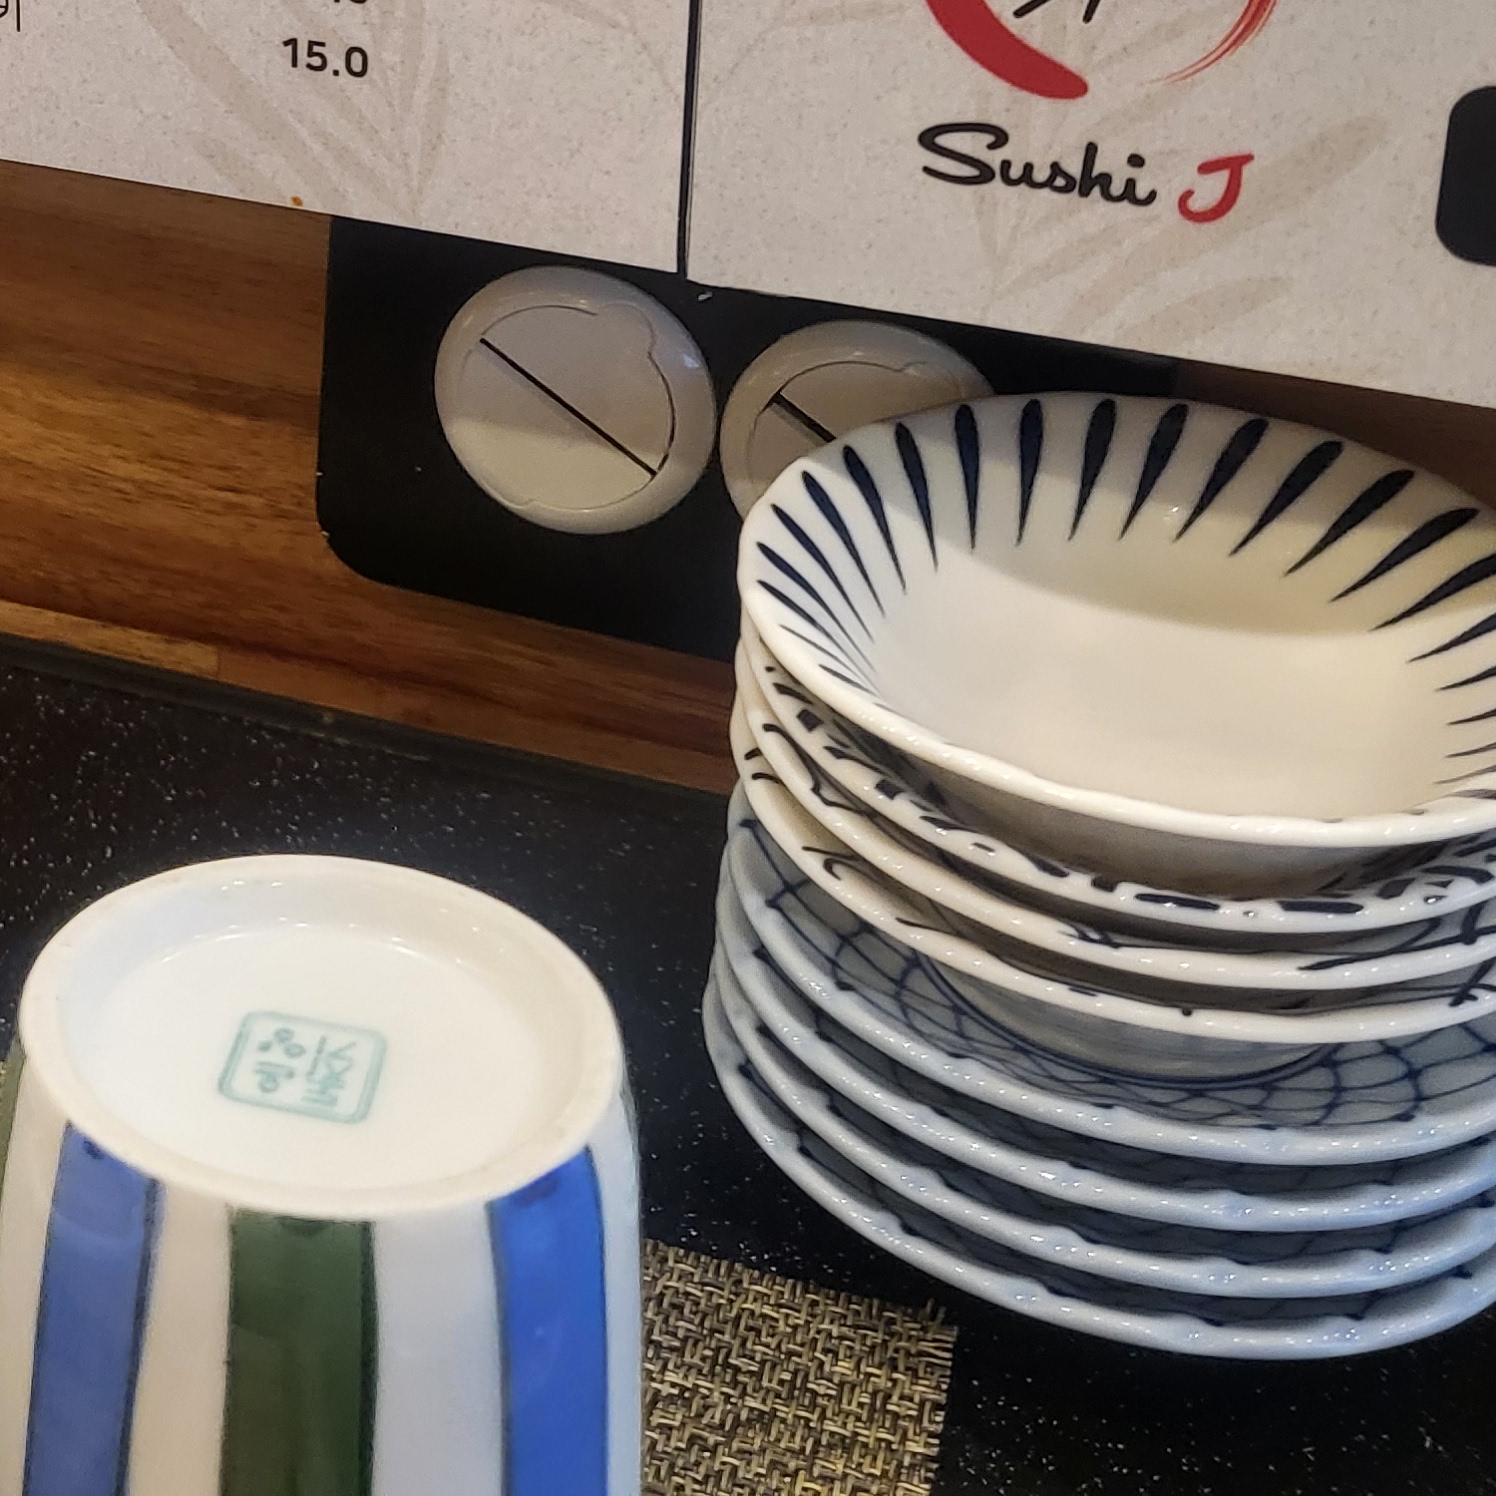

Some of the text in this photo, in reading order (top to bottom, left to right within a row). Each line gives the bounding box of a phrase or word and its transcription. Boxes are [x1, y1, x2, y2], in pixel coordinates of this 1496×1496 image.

[281, 36, 370, 79] 15.0
[916, 121, 1255, 225] Sushi J
